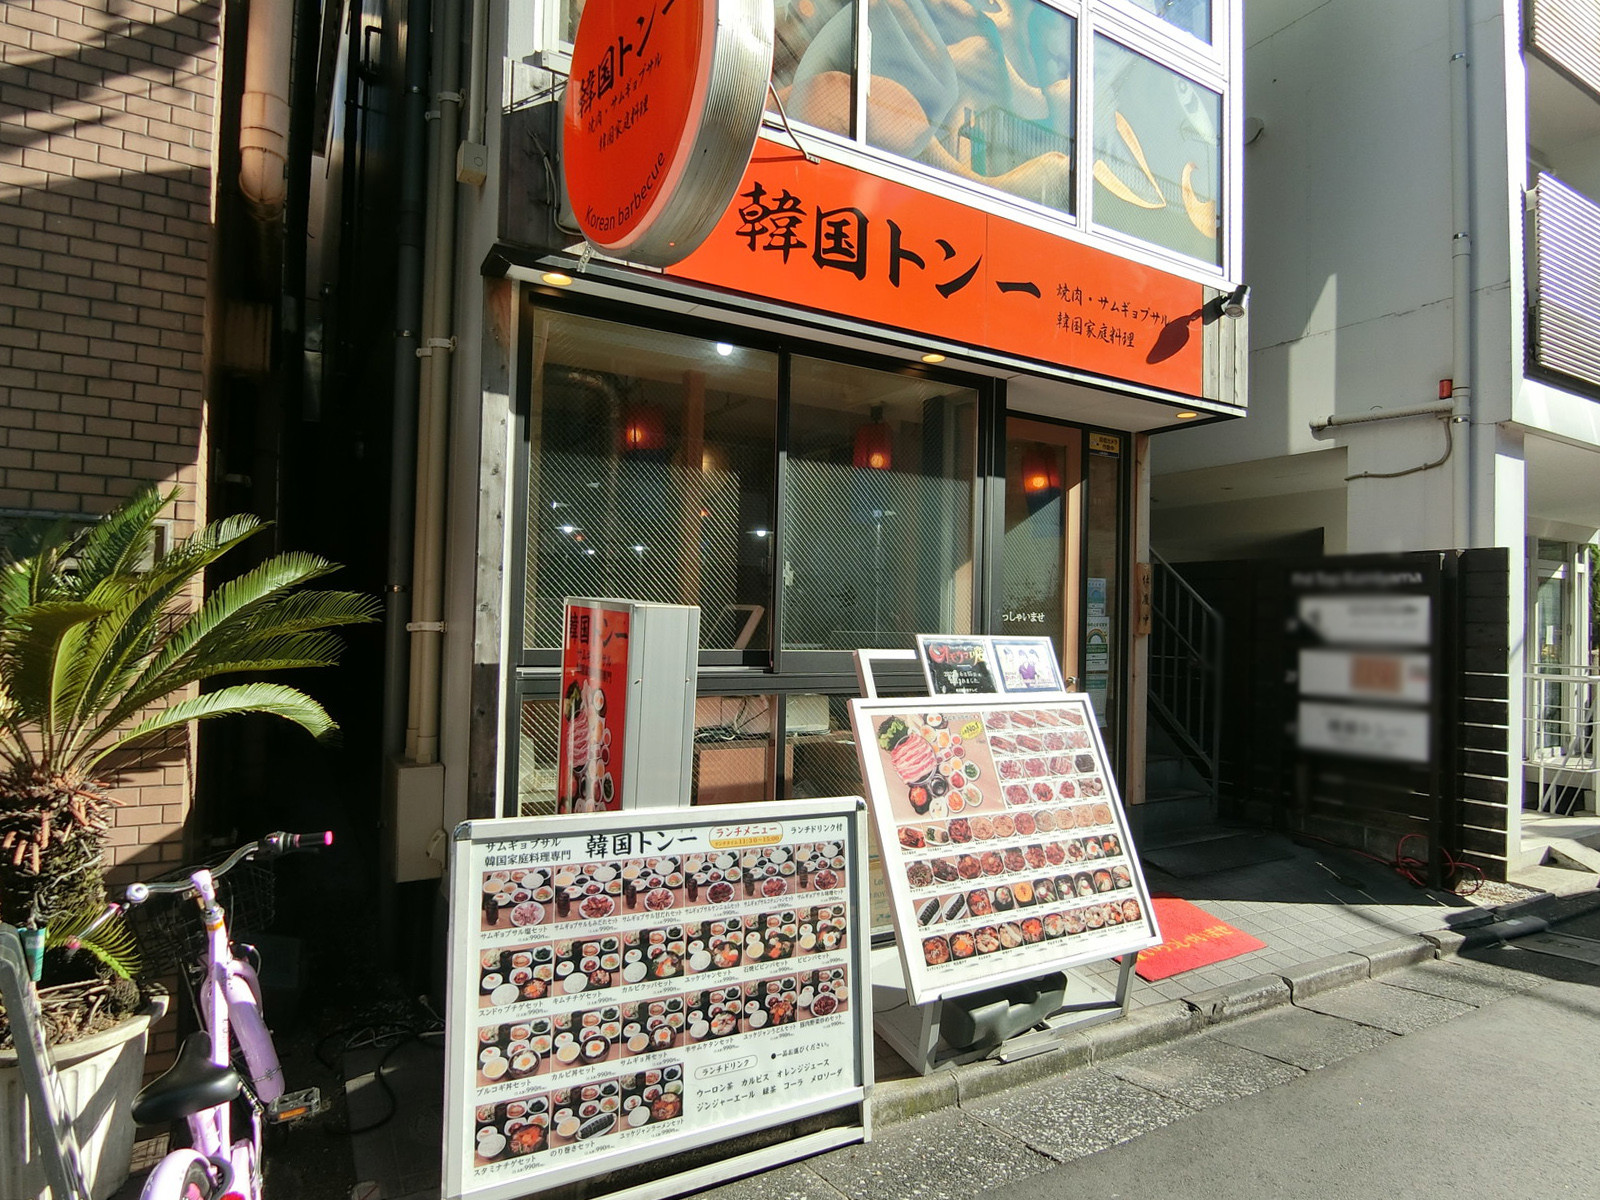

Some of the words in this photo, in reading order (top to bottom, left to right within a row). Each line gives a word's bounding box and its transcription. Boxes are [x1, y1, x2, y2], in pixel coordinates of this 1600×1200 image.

[585, 205, 616, 232] Korean
[617, 151, 665, 227] barbecue
[1056, 311, 1135, 348] 韓国家庭料理
[716, 825, 778, 838] ランチメニュー
[790, 823, 843, 835] ランチドリンク付
[485, 850, 571, 867] 韓国家庭料理専門
[696, 1081, 734, 1098] ウーロン茶
[741, 1073, 770, 1087] カルピス
[777, 1058, 830, 1078] オレンジジュース
[702, 1059, 750, 1076] ランチドリンク
[696, 1091, 756, 1112] ジンジャーエール
[783, 1079, 804, 1091] コーラ
